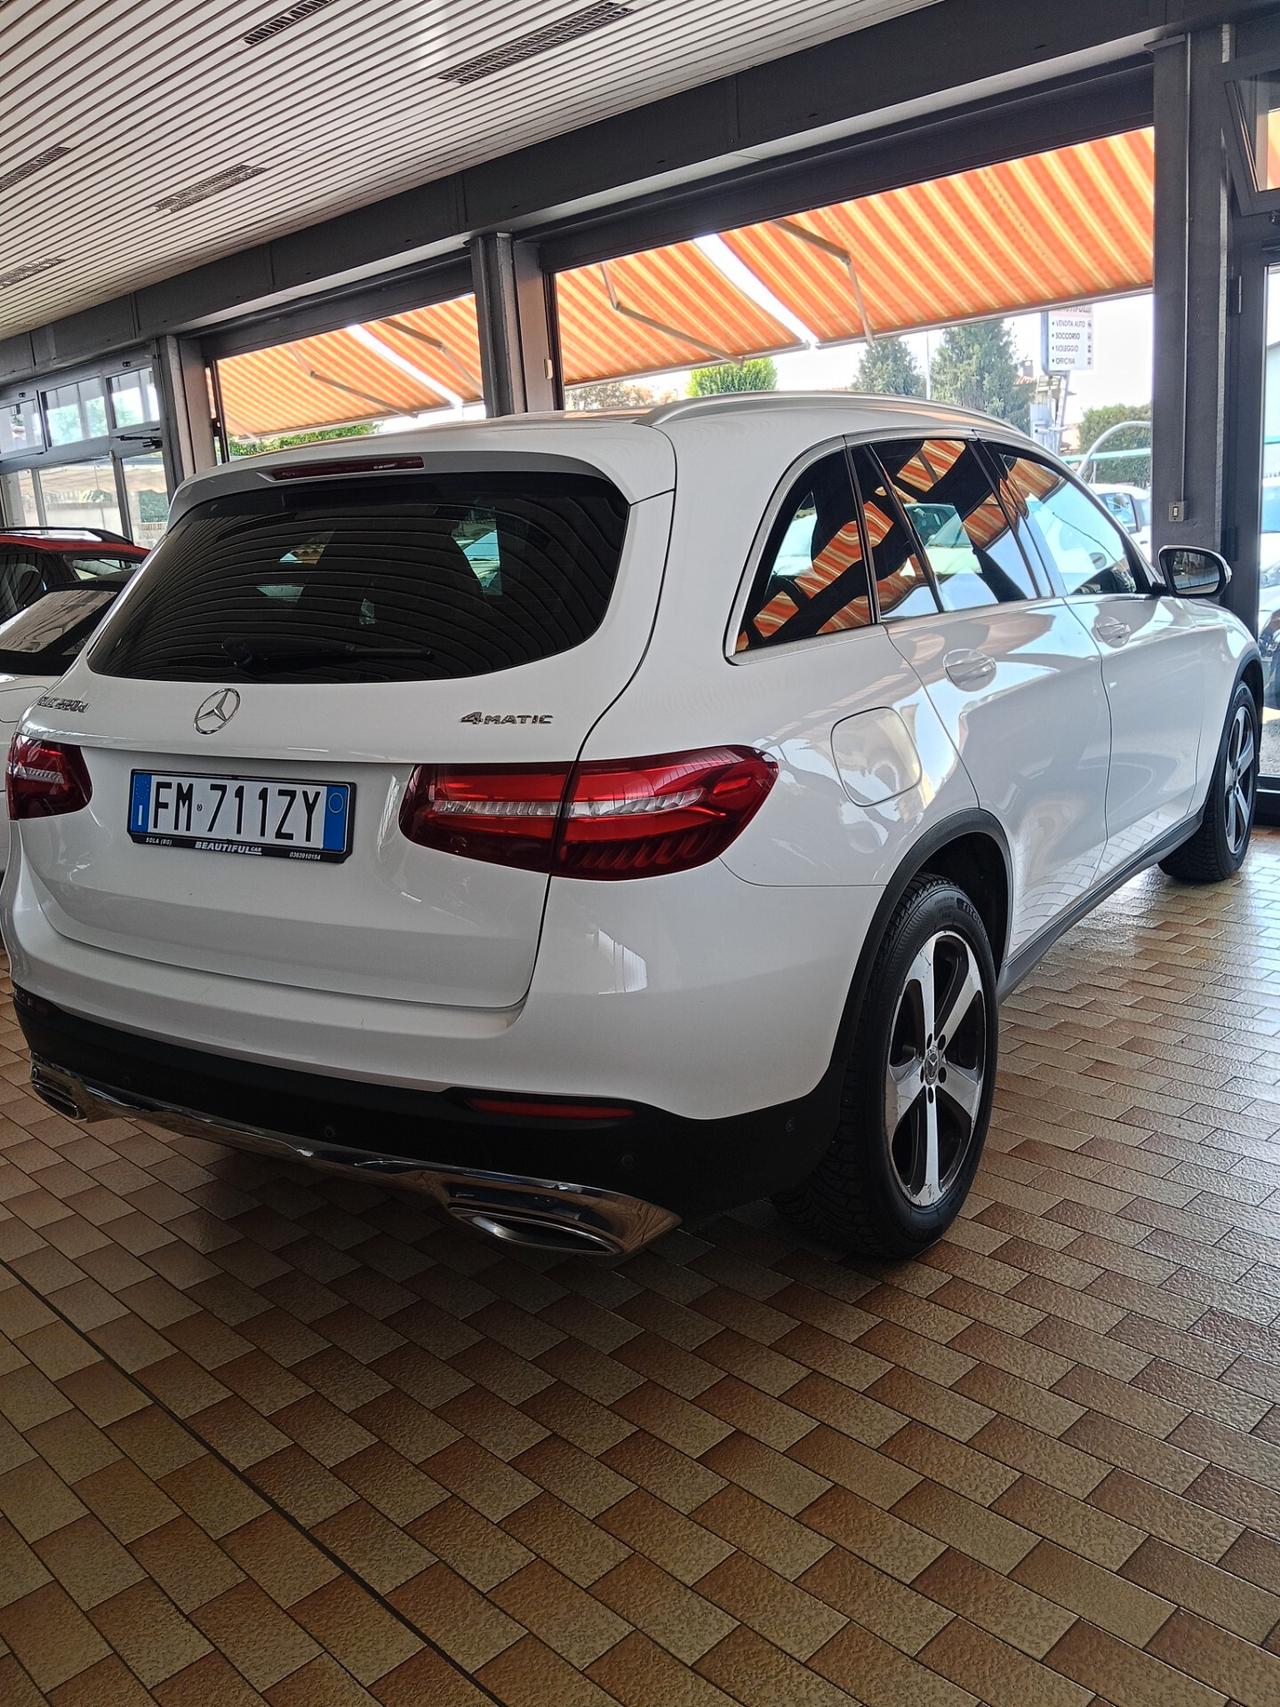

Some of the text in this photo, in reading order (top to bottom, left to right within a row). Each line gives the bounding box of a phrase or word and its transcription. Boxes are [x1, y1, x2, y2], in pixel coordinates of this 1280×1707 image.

[1074, 320, 1086, 328] AUTO
[1055, 332, 1081, 340] SOCCORSO
[1055, 344, 1079, 352] NOLEGGIO
[460, 711, 554, 725] 4MATIC
